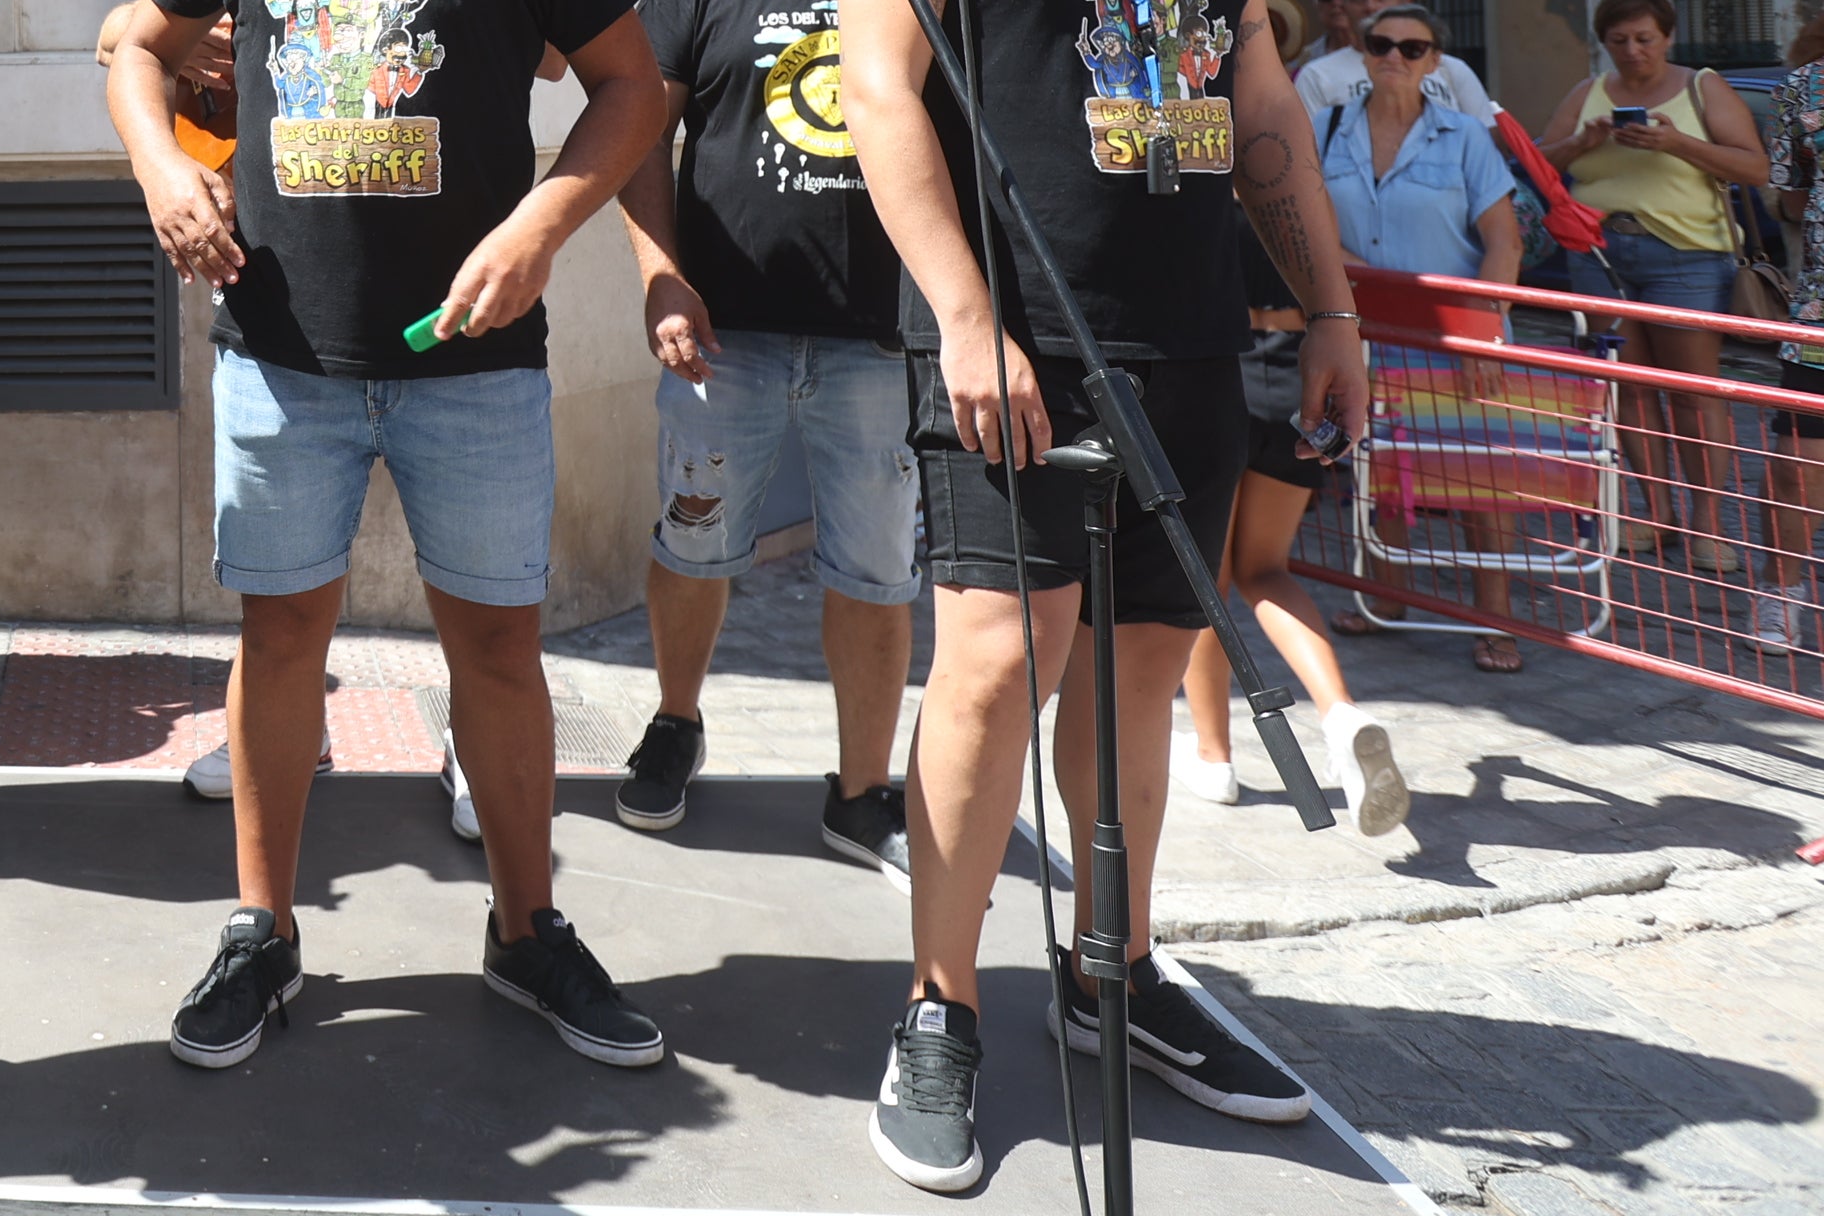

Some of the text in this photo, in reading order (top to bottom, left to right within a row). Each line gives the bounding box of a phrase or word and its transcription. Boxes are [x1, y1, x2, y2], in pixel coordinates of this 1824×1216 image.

[758, 12, 789, 26] LOS
[791, 11, 820, 25] DEL
[773, 45, 808, 84] SAN
[1101, 102, 1226, 123] Las Chrigotas
[279, 121, 426, 145] Las Chirigotas
[333, 144, 359, 161] del
[1105, 127, 1227, 165] Shriff
[280, 147, 427, 188] Sheriff
